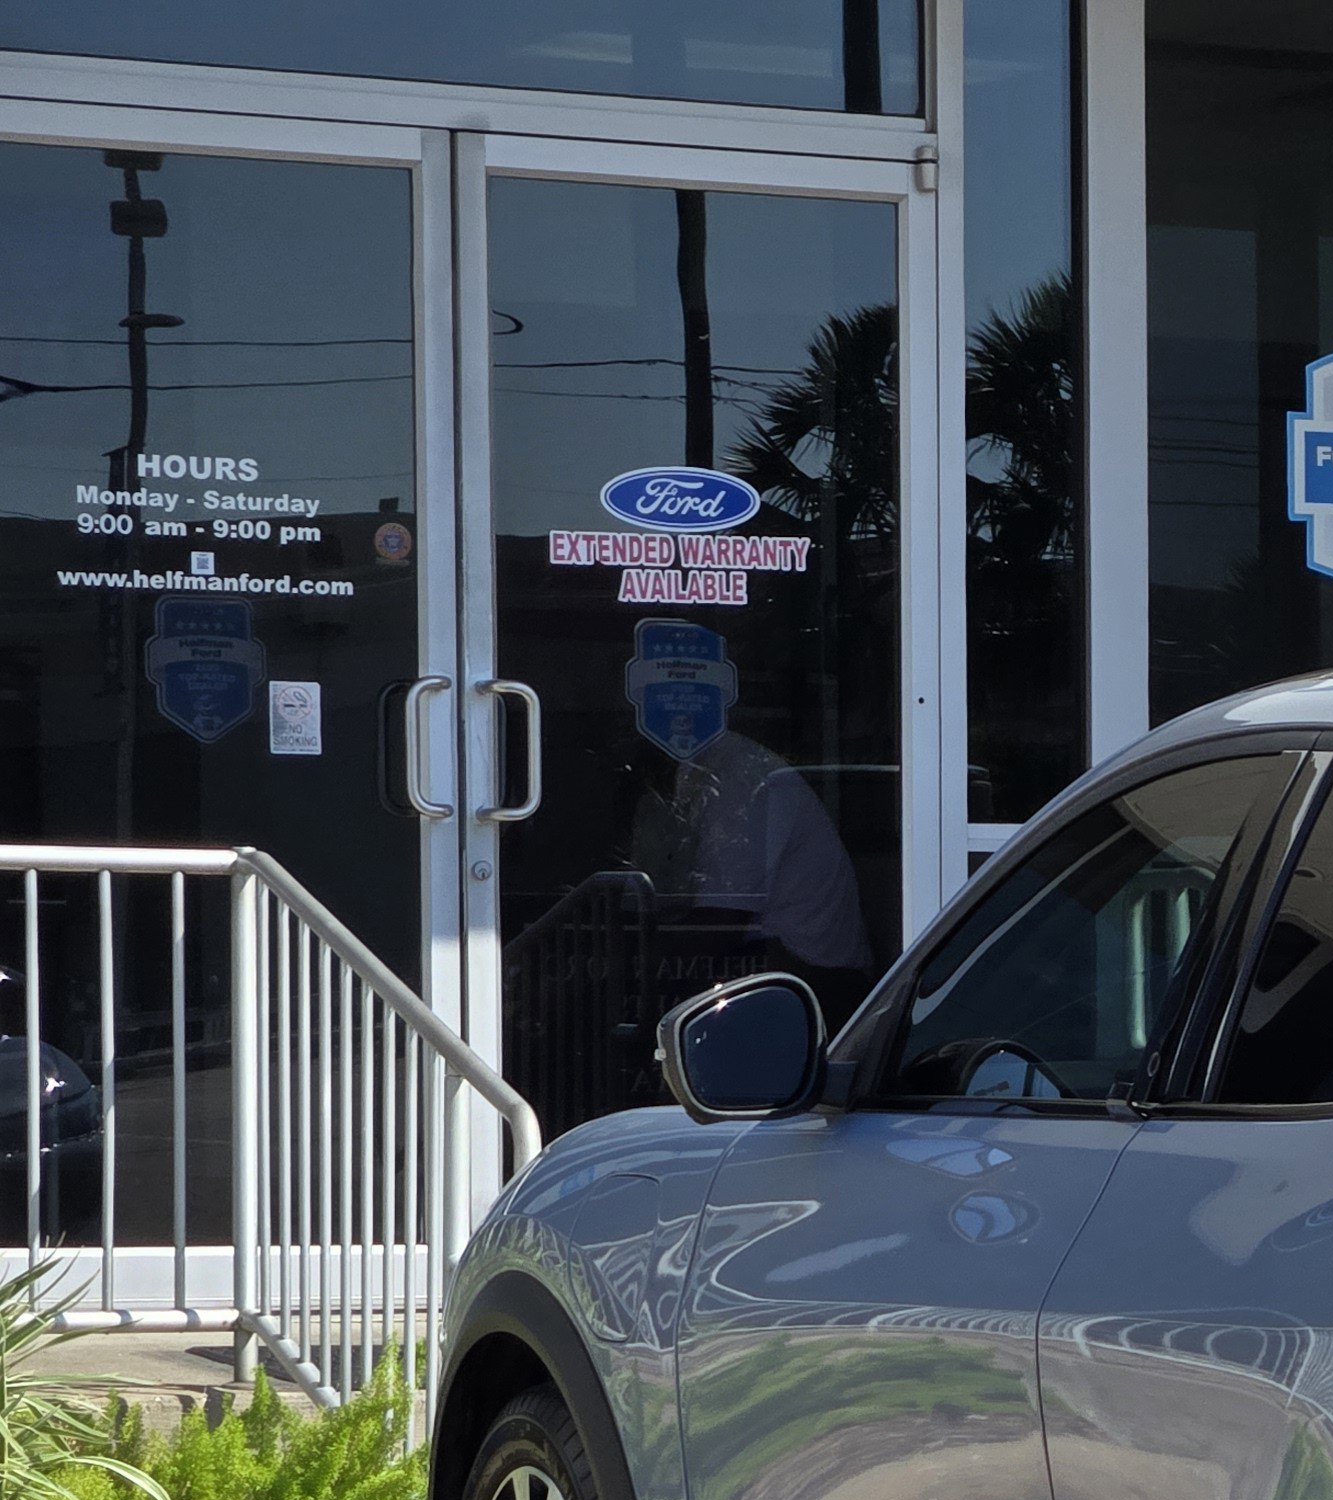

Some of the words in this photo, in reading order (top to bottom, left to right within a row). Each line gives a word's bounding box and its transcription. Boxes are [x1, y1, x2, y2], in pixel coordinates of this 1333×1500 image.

[136, 453, 259, 482] HOURS
[75, 485, 179, 511] Monday
[202, 490, 320, 518] Saturday
[635, 477, 727, 519] Ford
[76, 512, 134, 535] 9:00
[144, 519, 188, 538] am
[212, 519, 272, 541] 9:00
[279, 525, 322, 545] pm
[551, 531, 674, 566] EXTENDED
[680, 534, 810, 570] WARRANTY
[57, 569, 354, 596] www.helfmanford.com
[619, 570, 747, 604] AVAILABLE
[667, 670, 697, 679] Ford
[272, 735, 318, 747] SMOKING
[288, 724, 303, 735] NO
